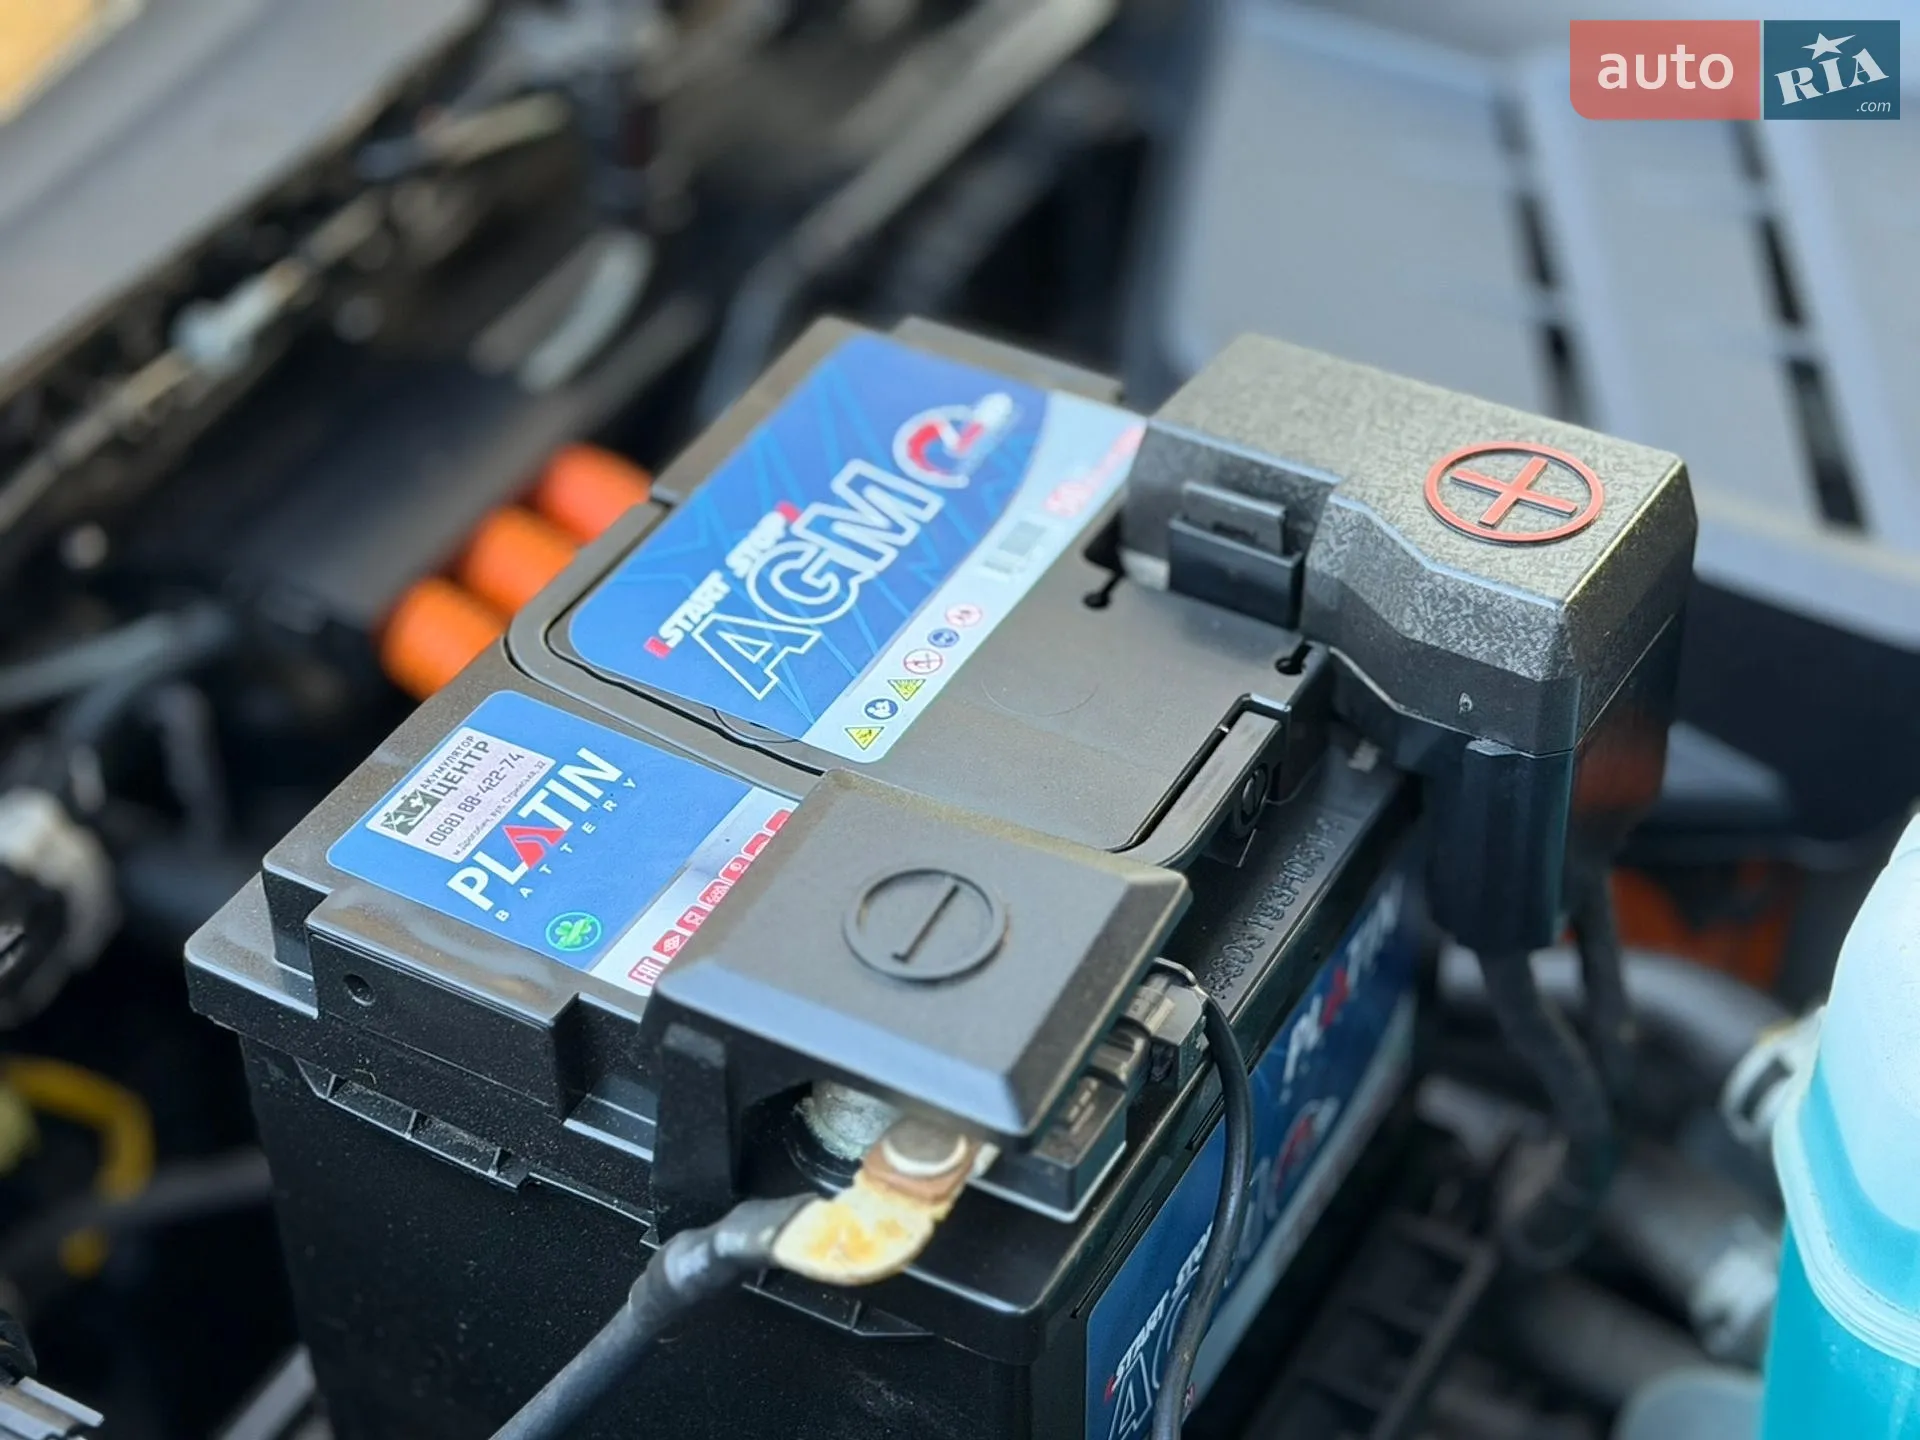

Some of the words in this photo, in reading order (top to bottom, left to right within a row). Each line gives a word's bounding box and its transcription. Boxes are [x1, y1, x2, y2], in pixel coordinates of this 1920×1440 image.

[658, 569, 731, 649] START
[691, 458, 946, 700] AGM
[420, 735, 474, 790] АКУМУЛЯТОР
[425, 813, 465, 846] (068)
[458, 752, 524, 813] 88-422-74
[431, 740, 490, 797] ЦЕНТР
[446, 747, 623, 911] PLATIN
[495, 777, 637, 922] BATTERY
